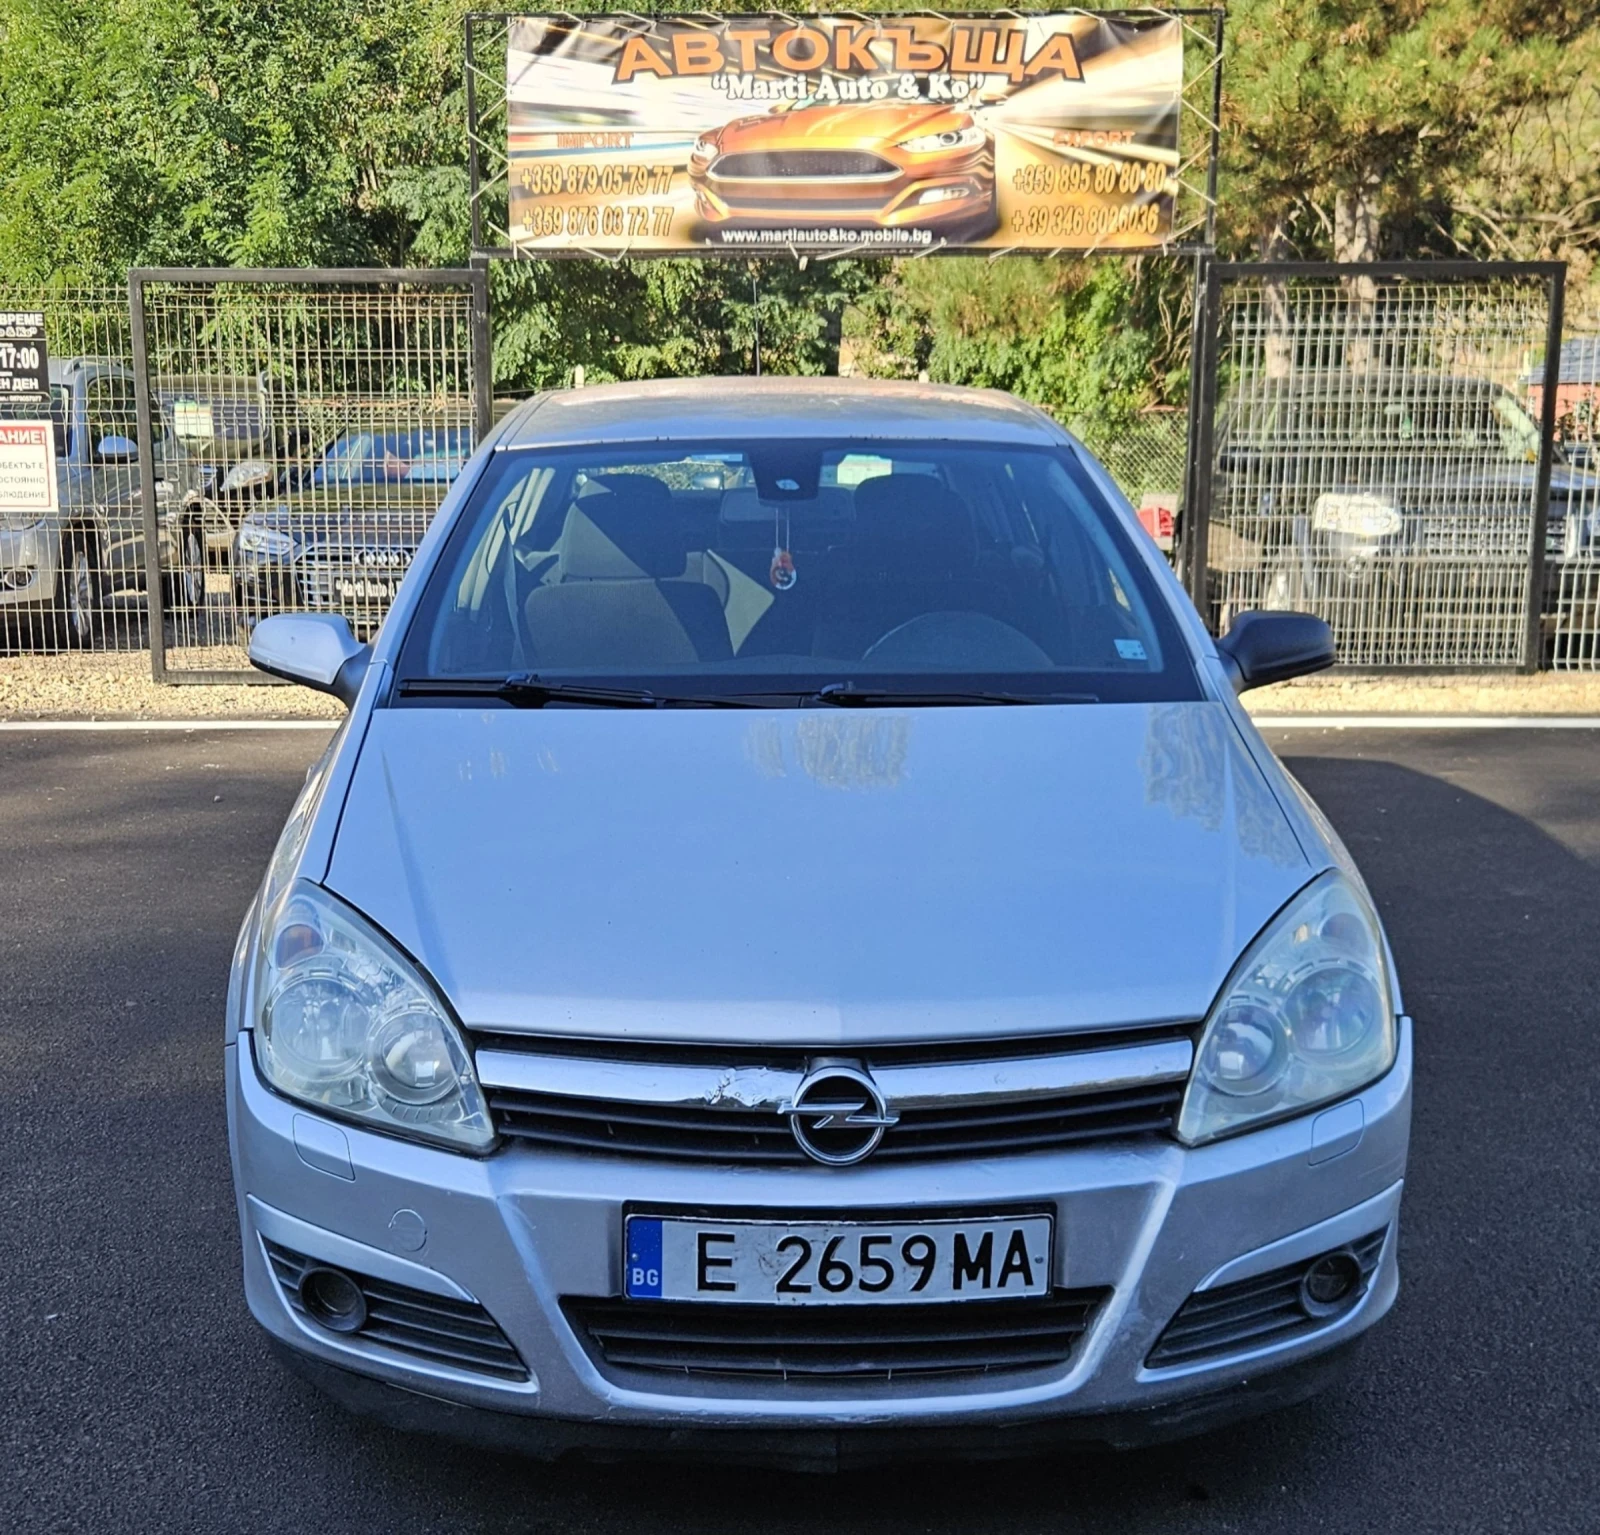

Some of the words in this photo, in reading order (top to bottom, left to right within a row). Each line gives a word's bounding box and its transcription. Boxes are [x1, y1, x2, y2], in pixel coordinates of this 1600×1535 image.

[614, 26, 1084, 83] АВТОКЪЩА
[711, 73, 807, 100] “Marti
[815, 74, 888, 100] Auto
[897, 73, 920, 100] &
[927, 73, 985, 100] Ko”
[557, 132, 634, 148] IMPORT
[1053, 131, 1135, 146] EXPORT
[520, 164, 563, 195] +359
[566, 164, 599, 195] 879
[601, 164, 624, 195] 05
[627, 164, 649, 195] 79
[652, 164, 674, 195] 77
[1012, 164, 1056, 195] +359
[1058, 163, 1092, 194] 895
[1094, 163, 1117, 194] 80
[1119, 161, 1141, 193] 80
[1144, 161, 1167, 193] 80
[522, 205, 563, 236] +359
[567, 205, 599, 236] 876
[602, 205, 624, 236] 03
[628, 206, 649, 236] 72
[652, 206, 674, 236] 77
[1011, 209, 1024, 233] +
[1026, 205, 1049, 236] 39
[1051, 205, 1084, 236] 346
[1086, 203, 1160, 235] 8026036
[721, 228, 932, 244] www.martiauto&ko.mobile.bg
[12, 378, 39, 391] ДЕН
[696, 1231, 737, 1292] E
[775, 1234, 937, 1293] 2659
[951, 1229, 1035, 1290] MA
[632, 1267, 659, 1285] BG
